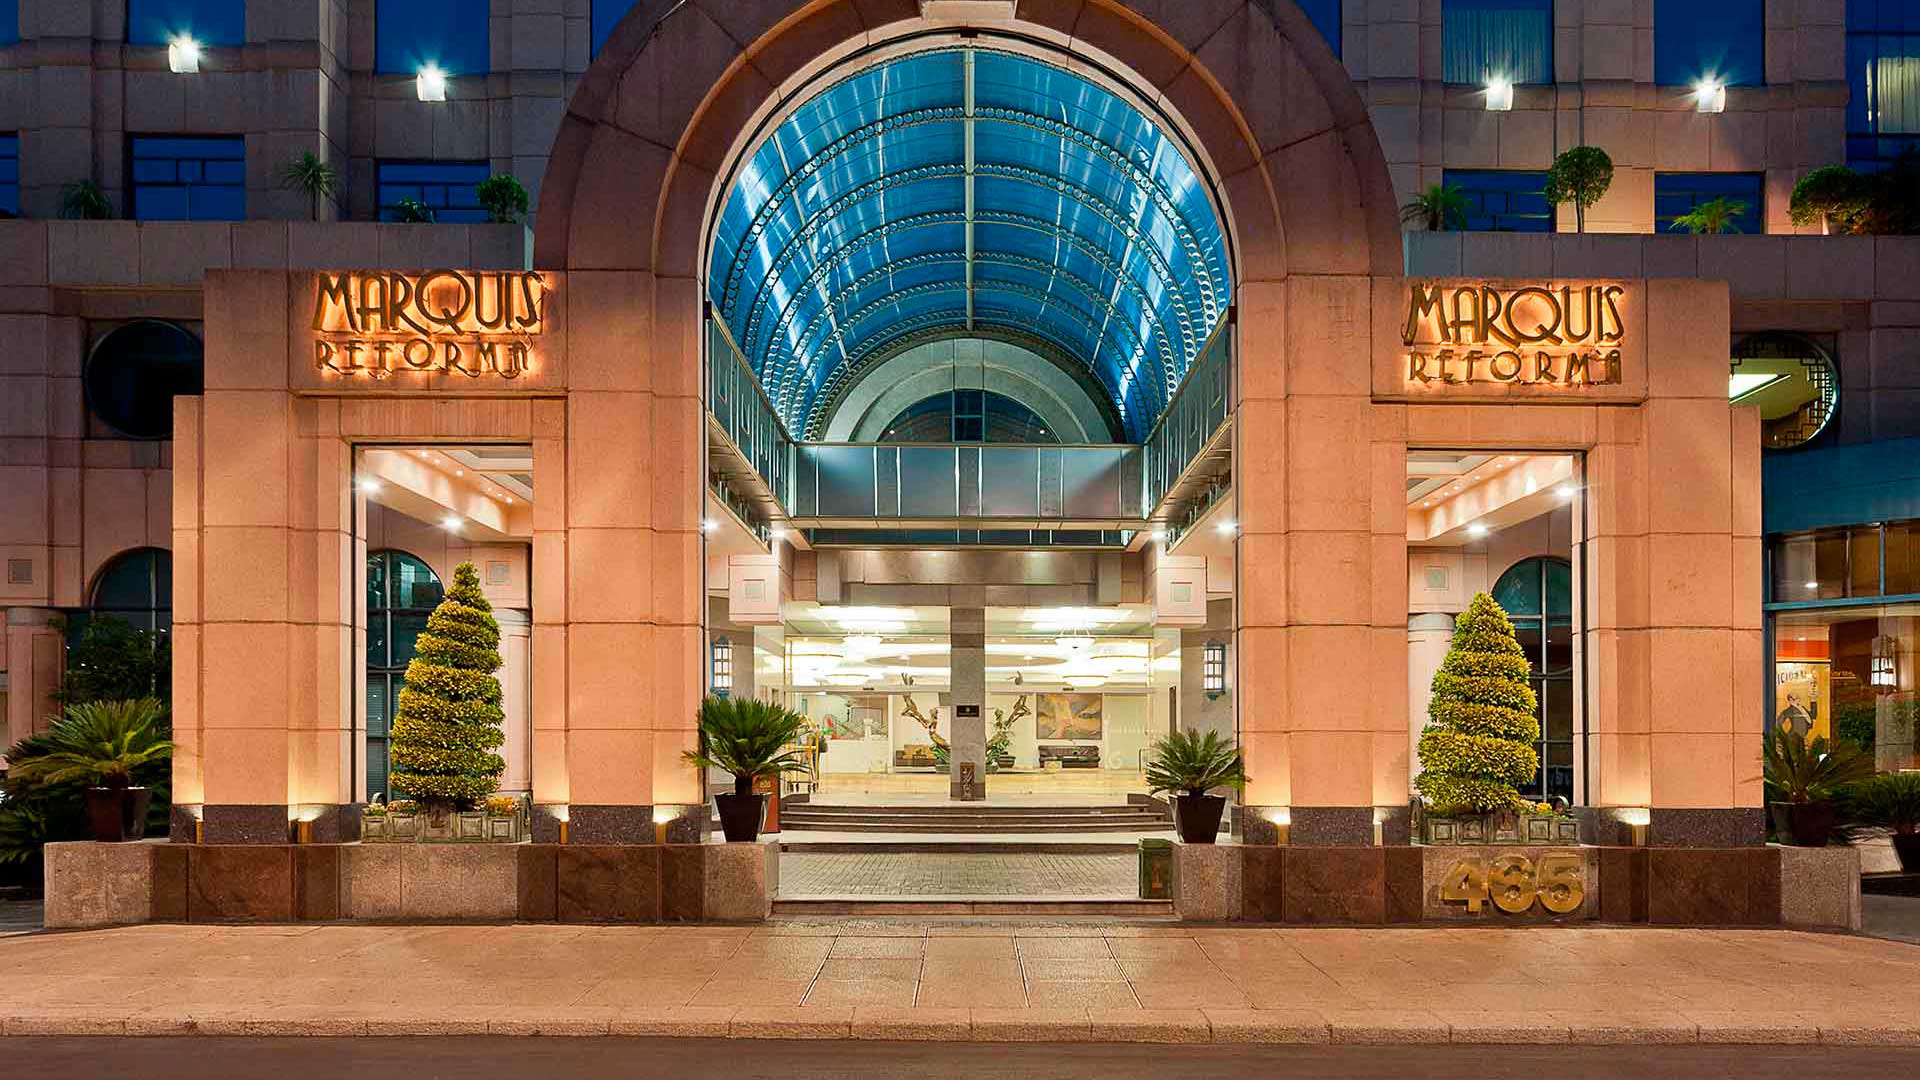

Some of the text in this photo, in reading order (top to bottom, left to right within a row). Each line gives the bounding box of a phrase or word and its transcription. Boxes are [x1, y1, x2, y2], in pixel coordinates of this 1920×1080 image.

[312, 269, 549, 337] MARQUIS
[1401, 284, 1625, 348] MARQUIS
[315, 338, 529, 375] REFORMA
[1409, 349, 1622, 385] REFORMA
[1440, 853, 1585, 914] 465
